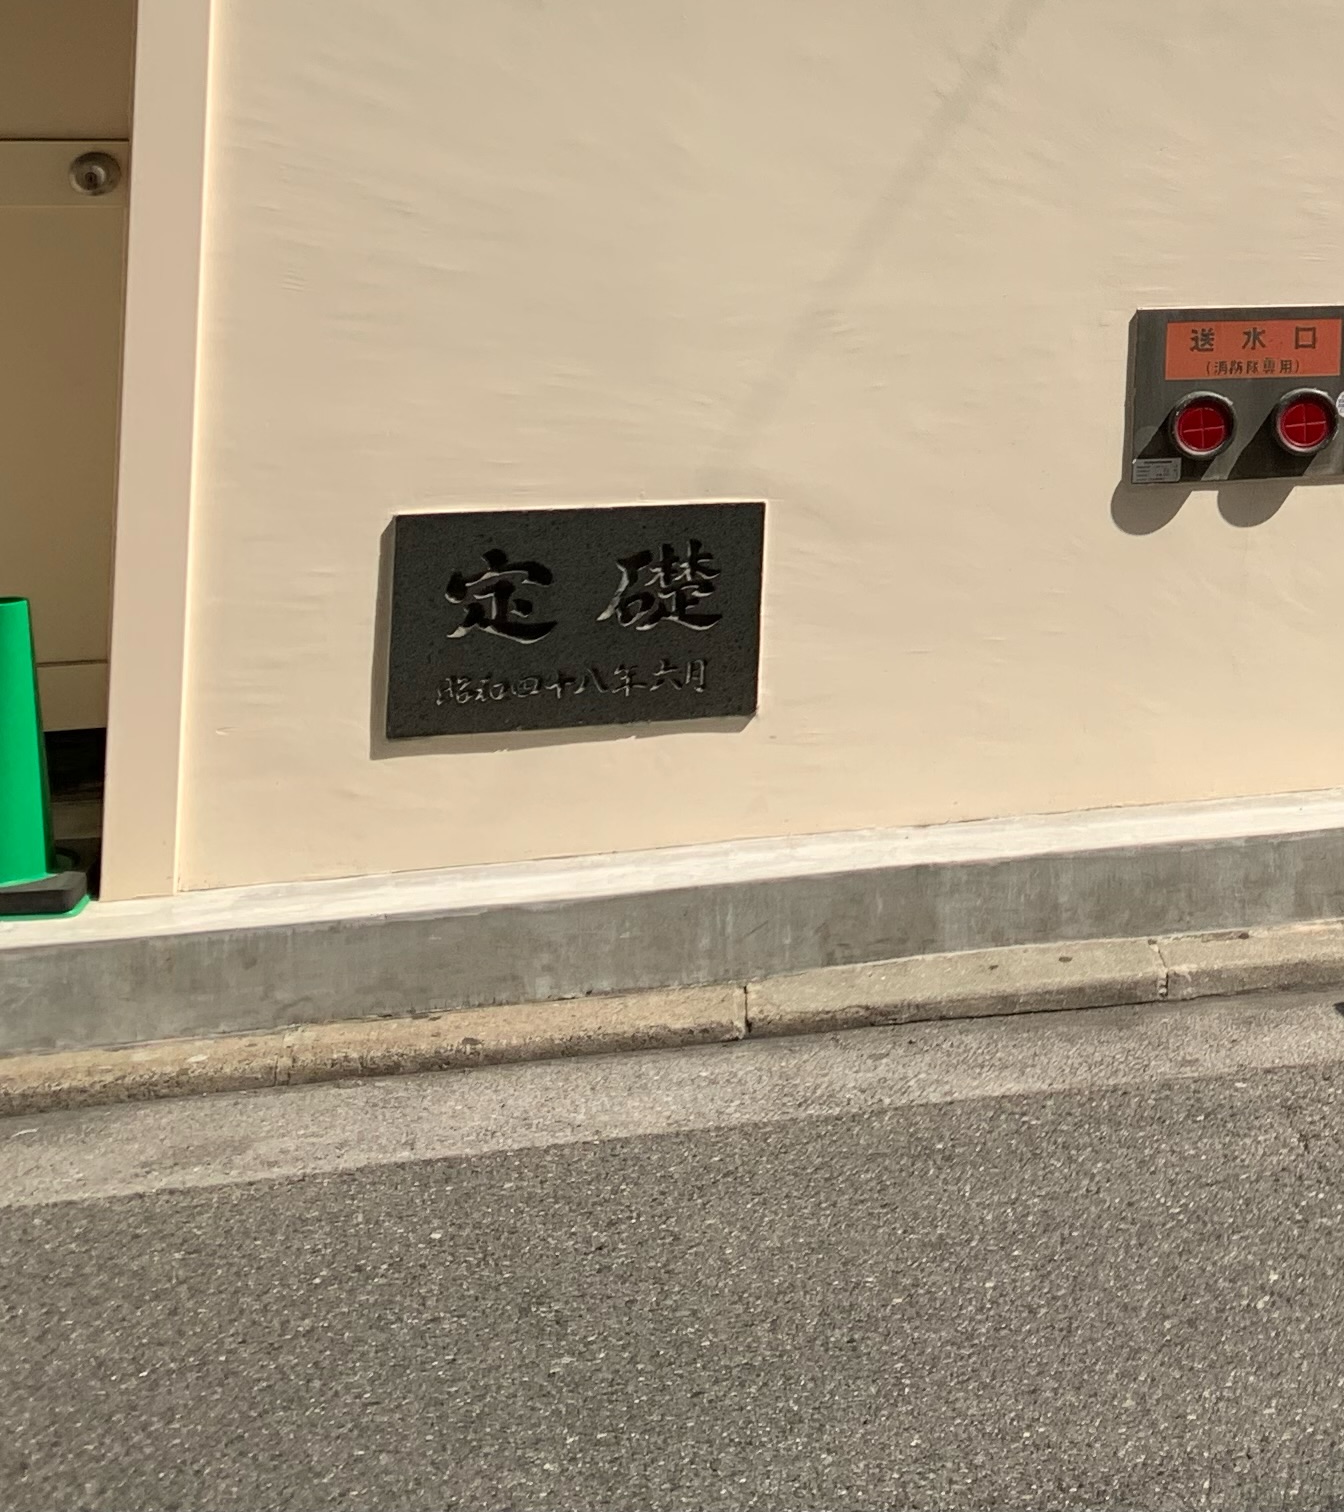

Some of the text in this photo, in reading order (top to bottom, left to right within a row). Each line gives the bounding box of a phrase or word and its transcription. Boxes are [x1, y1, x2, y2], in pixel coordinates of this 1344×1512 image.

[1189, 326, 1317, 352] 送水口
[444, 537, 723, 645] 定礎
